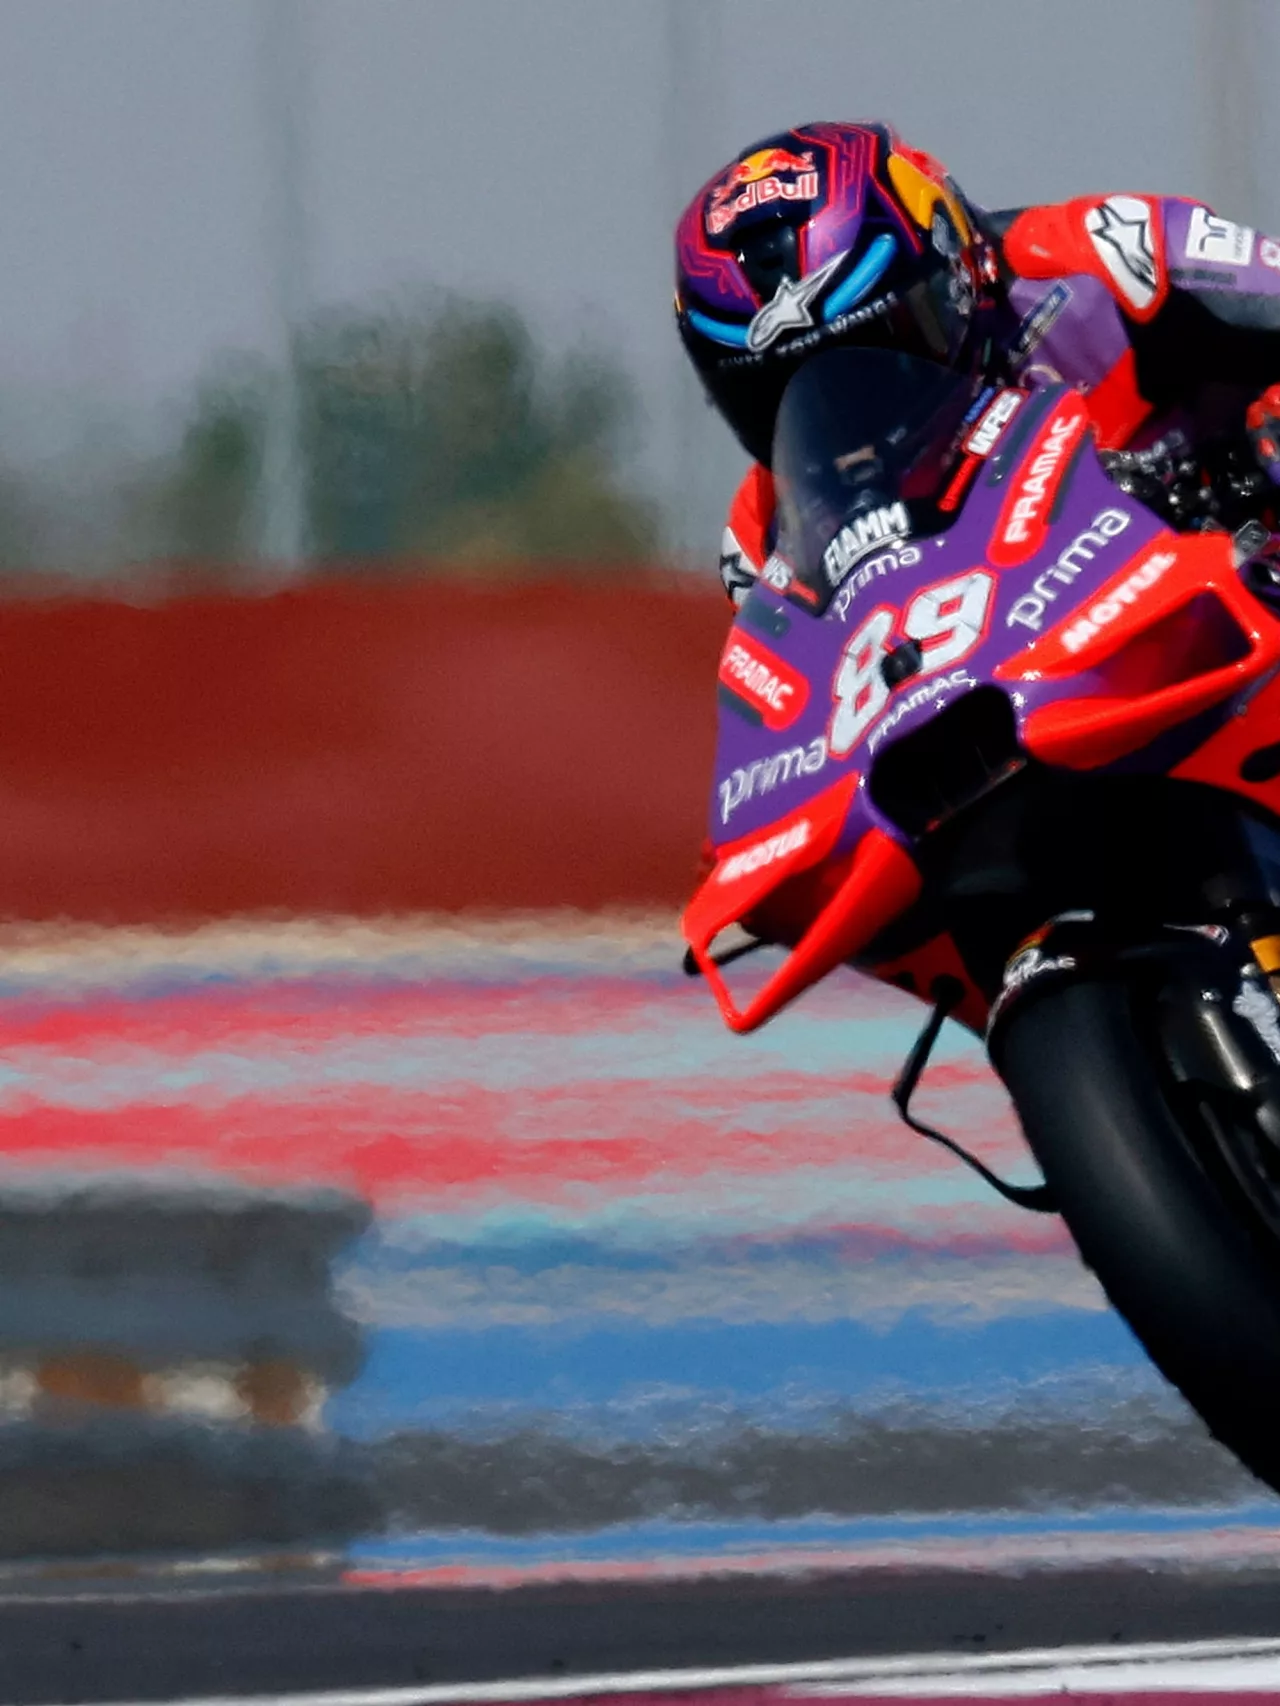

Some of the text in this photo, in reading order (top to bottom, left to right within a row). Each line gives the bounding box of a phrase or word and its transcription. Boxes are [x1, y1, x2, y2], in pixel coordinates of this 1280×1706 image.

[756, 172, 819, 204] Bull
[1004, 414, 1081, 544] PRAMAC
[823, 501, 910, 587] FIAMM
[832, 546, 923, 622] prima
[1006, 508, 1132, 631] prima
[1061, 552, 1178, 654] MOTUL
[721, 644, 794, 711] PRAMAC
[829, 568, 997, 759] 89
[718, 736, 828, 825] prima
